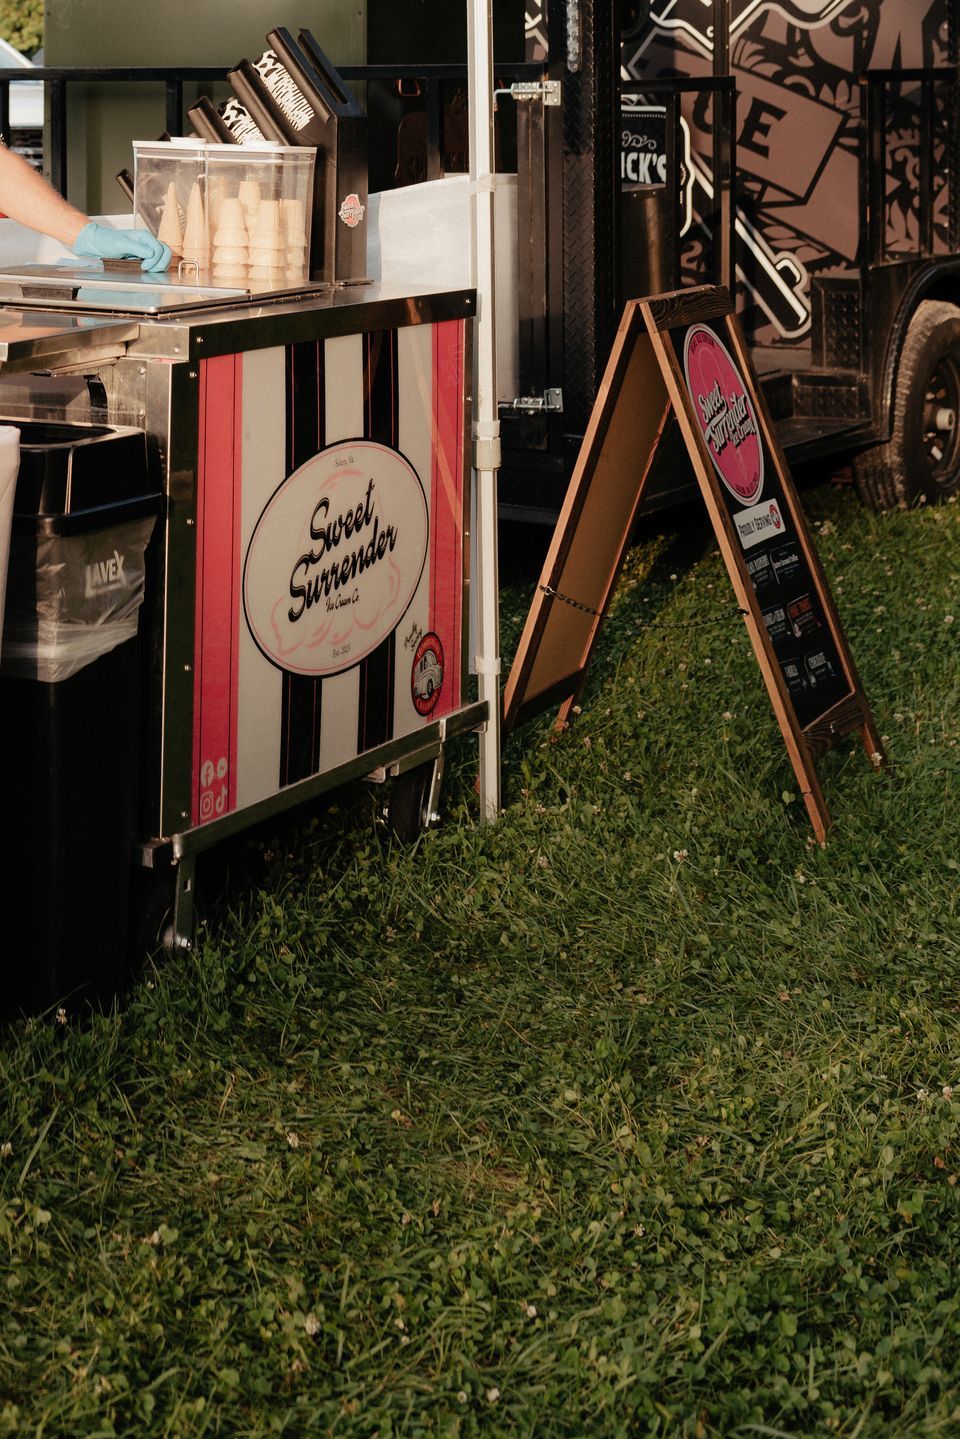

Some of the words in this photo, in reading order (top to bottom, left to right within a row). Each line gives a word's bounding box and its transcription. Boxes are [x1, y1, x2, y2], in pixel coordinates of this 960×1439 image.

[699, 380, 724, 424] Sweet
[708, 392, 748, 454] Surrender
[310, 478, 376, 564] Sweet
[85, 550, 127, 598] LAVEX
[288, 515, 399, 623] Surrender
